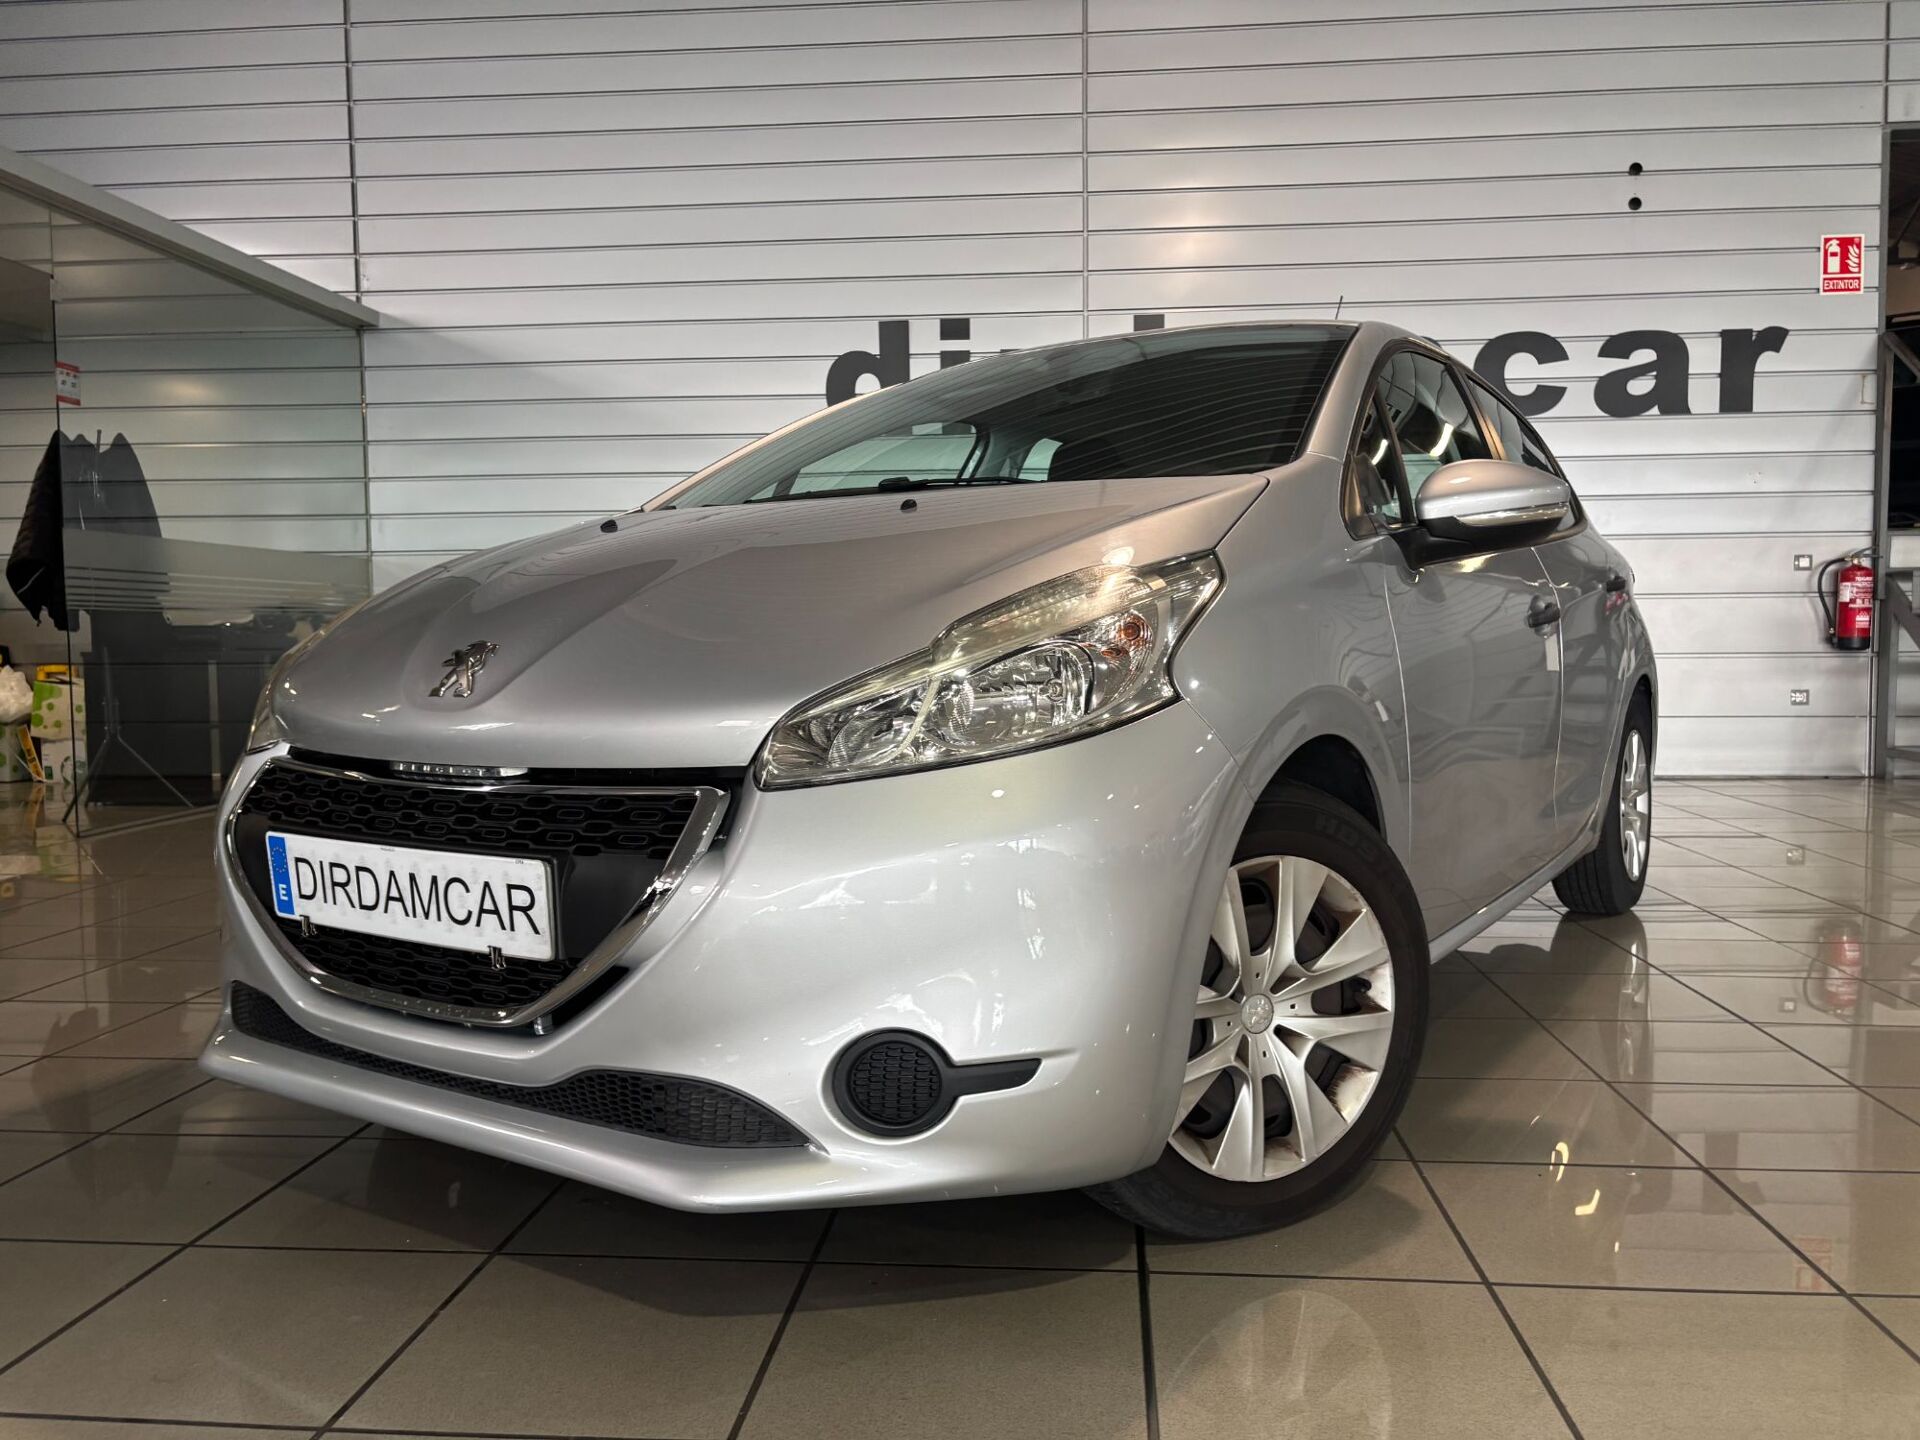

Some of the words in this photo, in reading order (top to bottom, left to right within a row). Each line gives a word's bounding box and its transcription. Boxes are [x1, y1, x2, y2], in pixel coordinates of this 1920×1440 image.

[1823, 279, 1860, 290] EXTINTOR
[278, 882, 289, 902] E
[293, 856, 542, 936] DIRDAMCAR
